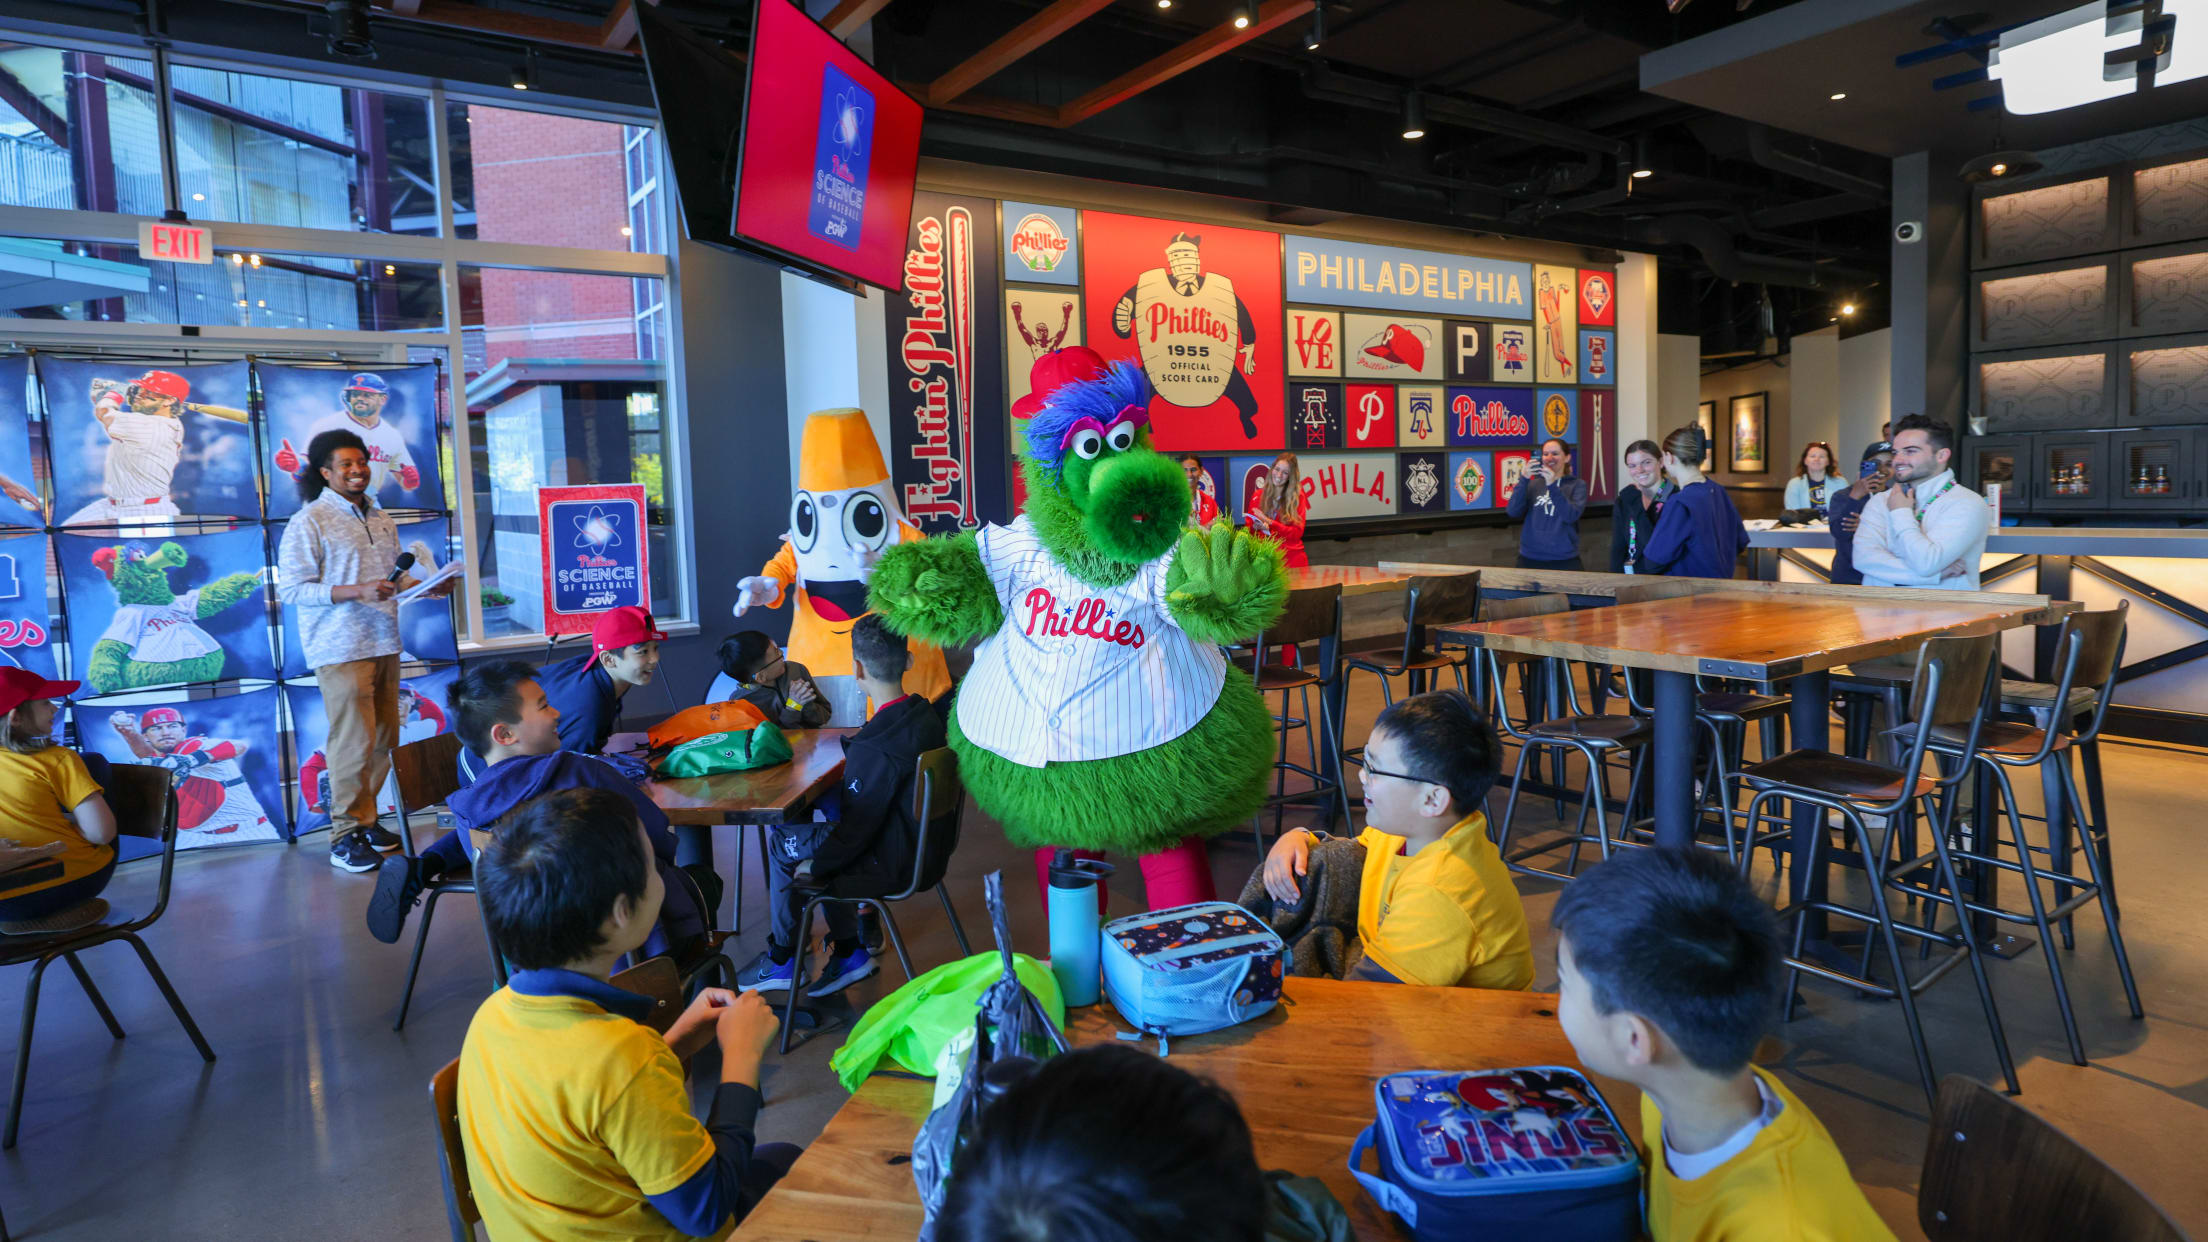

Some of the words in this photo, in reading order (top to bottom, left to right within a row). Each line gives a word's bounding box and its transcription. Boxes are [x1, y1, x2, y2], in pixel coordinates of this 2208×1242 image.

[816, 169, 863, 210] SCIENCE
[817, 192, 826, 204] OF
[828, 197, 859, 222] BASEBALL
[151, 224, 204, 260] EXIT
[901, 216, 956, 376] Phillies
[1297, 251, 1523, 305] PHILADELPHIA
[1145, 302, 1228, 343] Phillies
[1168, 344, 1209, 357] 1955
[1170, 361, 1211, 371] OFFICIAL
[1456, 326, 1478, 375] P
[1161, 373, 1191, 383] SCORE
[1195, 375, 1219, 384] CARD
[1356, 391, 1384, 441] P
[1452, 394, 1529, 437] Phillies
[1300, 463, 1390, 510] PHILA.
[1463, 476, 1477, 486] 100
[558, 566, 635, 584] SCIENCE
[563, 584, 575, 592] OF
[581, 581, 633, 591] BASEBALL
[584, 595, 616, 608] PGW
[1025, 587, 1145, 649] Phillies
